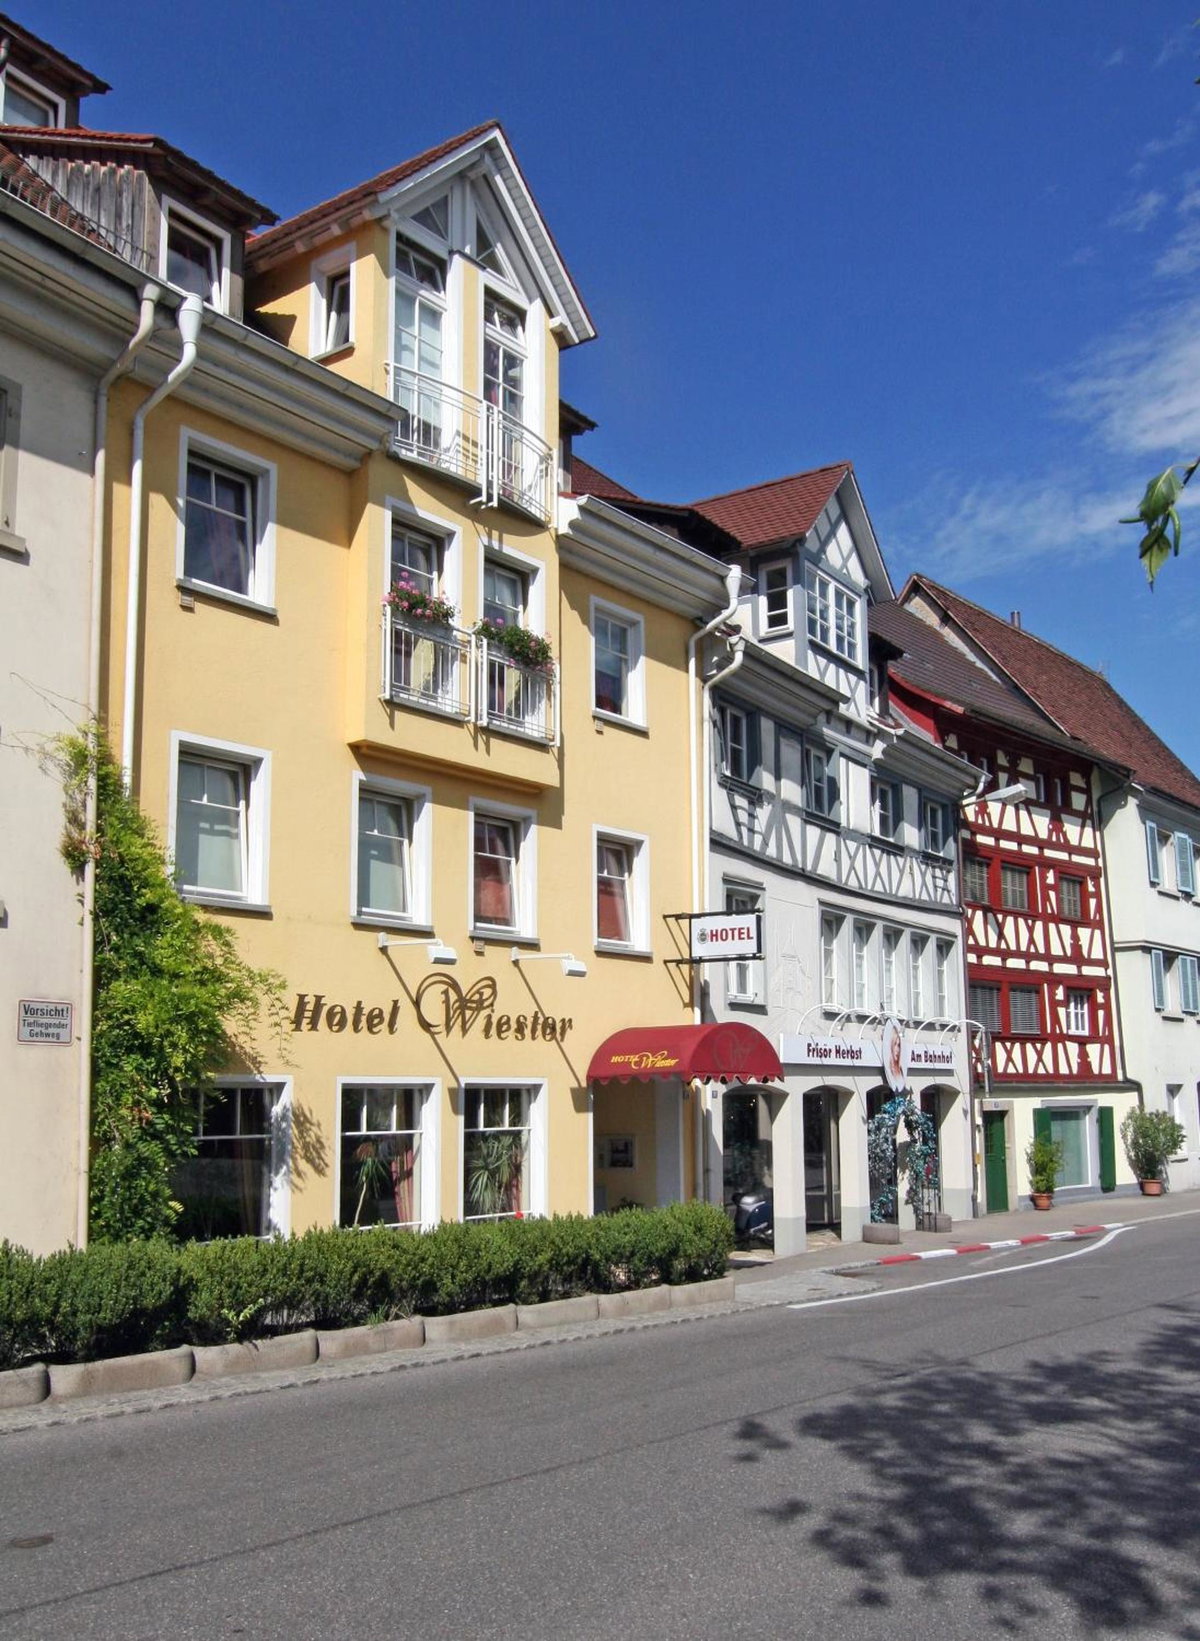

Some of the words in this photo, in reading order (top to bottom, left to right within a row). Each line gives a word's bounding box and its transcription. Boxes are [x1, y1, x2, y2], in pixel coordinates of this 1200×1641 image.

[709, 927, 753, 942] HOTEL
[23, 1004, 69, 1018] Vorsicht!
[290, 993, 401, 1036] Hotel
[415, 971, 573, 1043] Wiester
[22, 1019, 68, 1030] Tiefliegender
[28, 1029, 61, 1040] Gehweg
[806, 1042, 832, 1060] Frisör
[834, 1044, 862, 1061] Herbst
[910, 1049, 923, 1064] Am
[924, 1050, 953, 1065] Bahnhof
